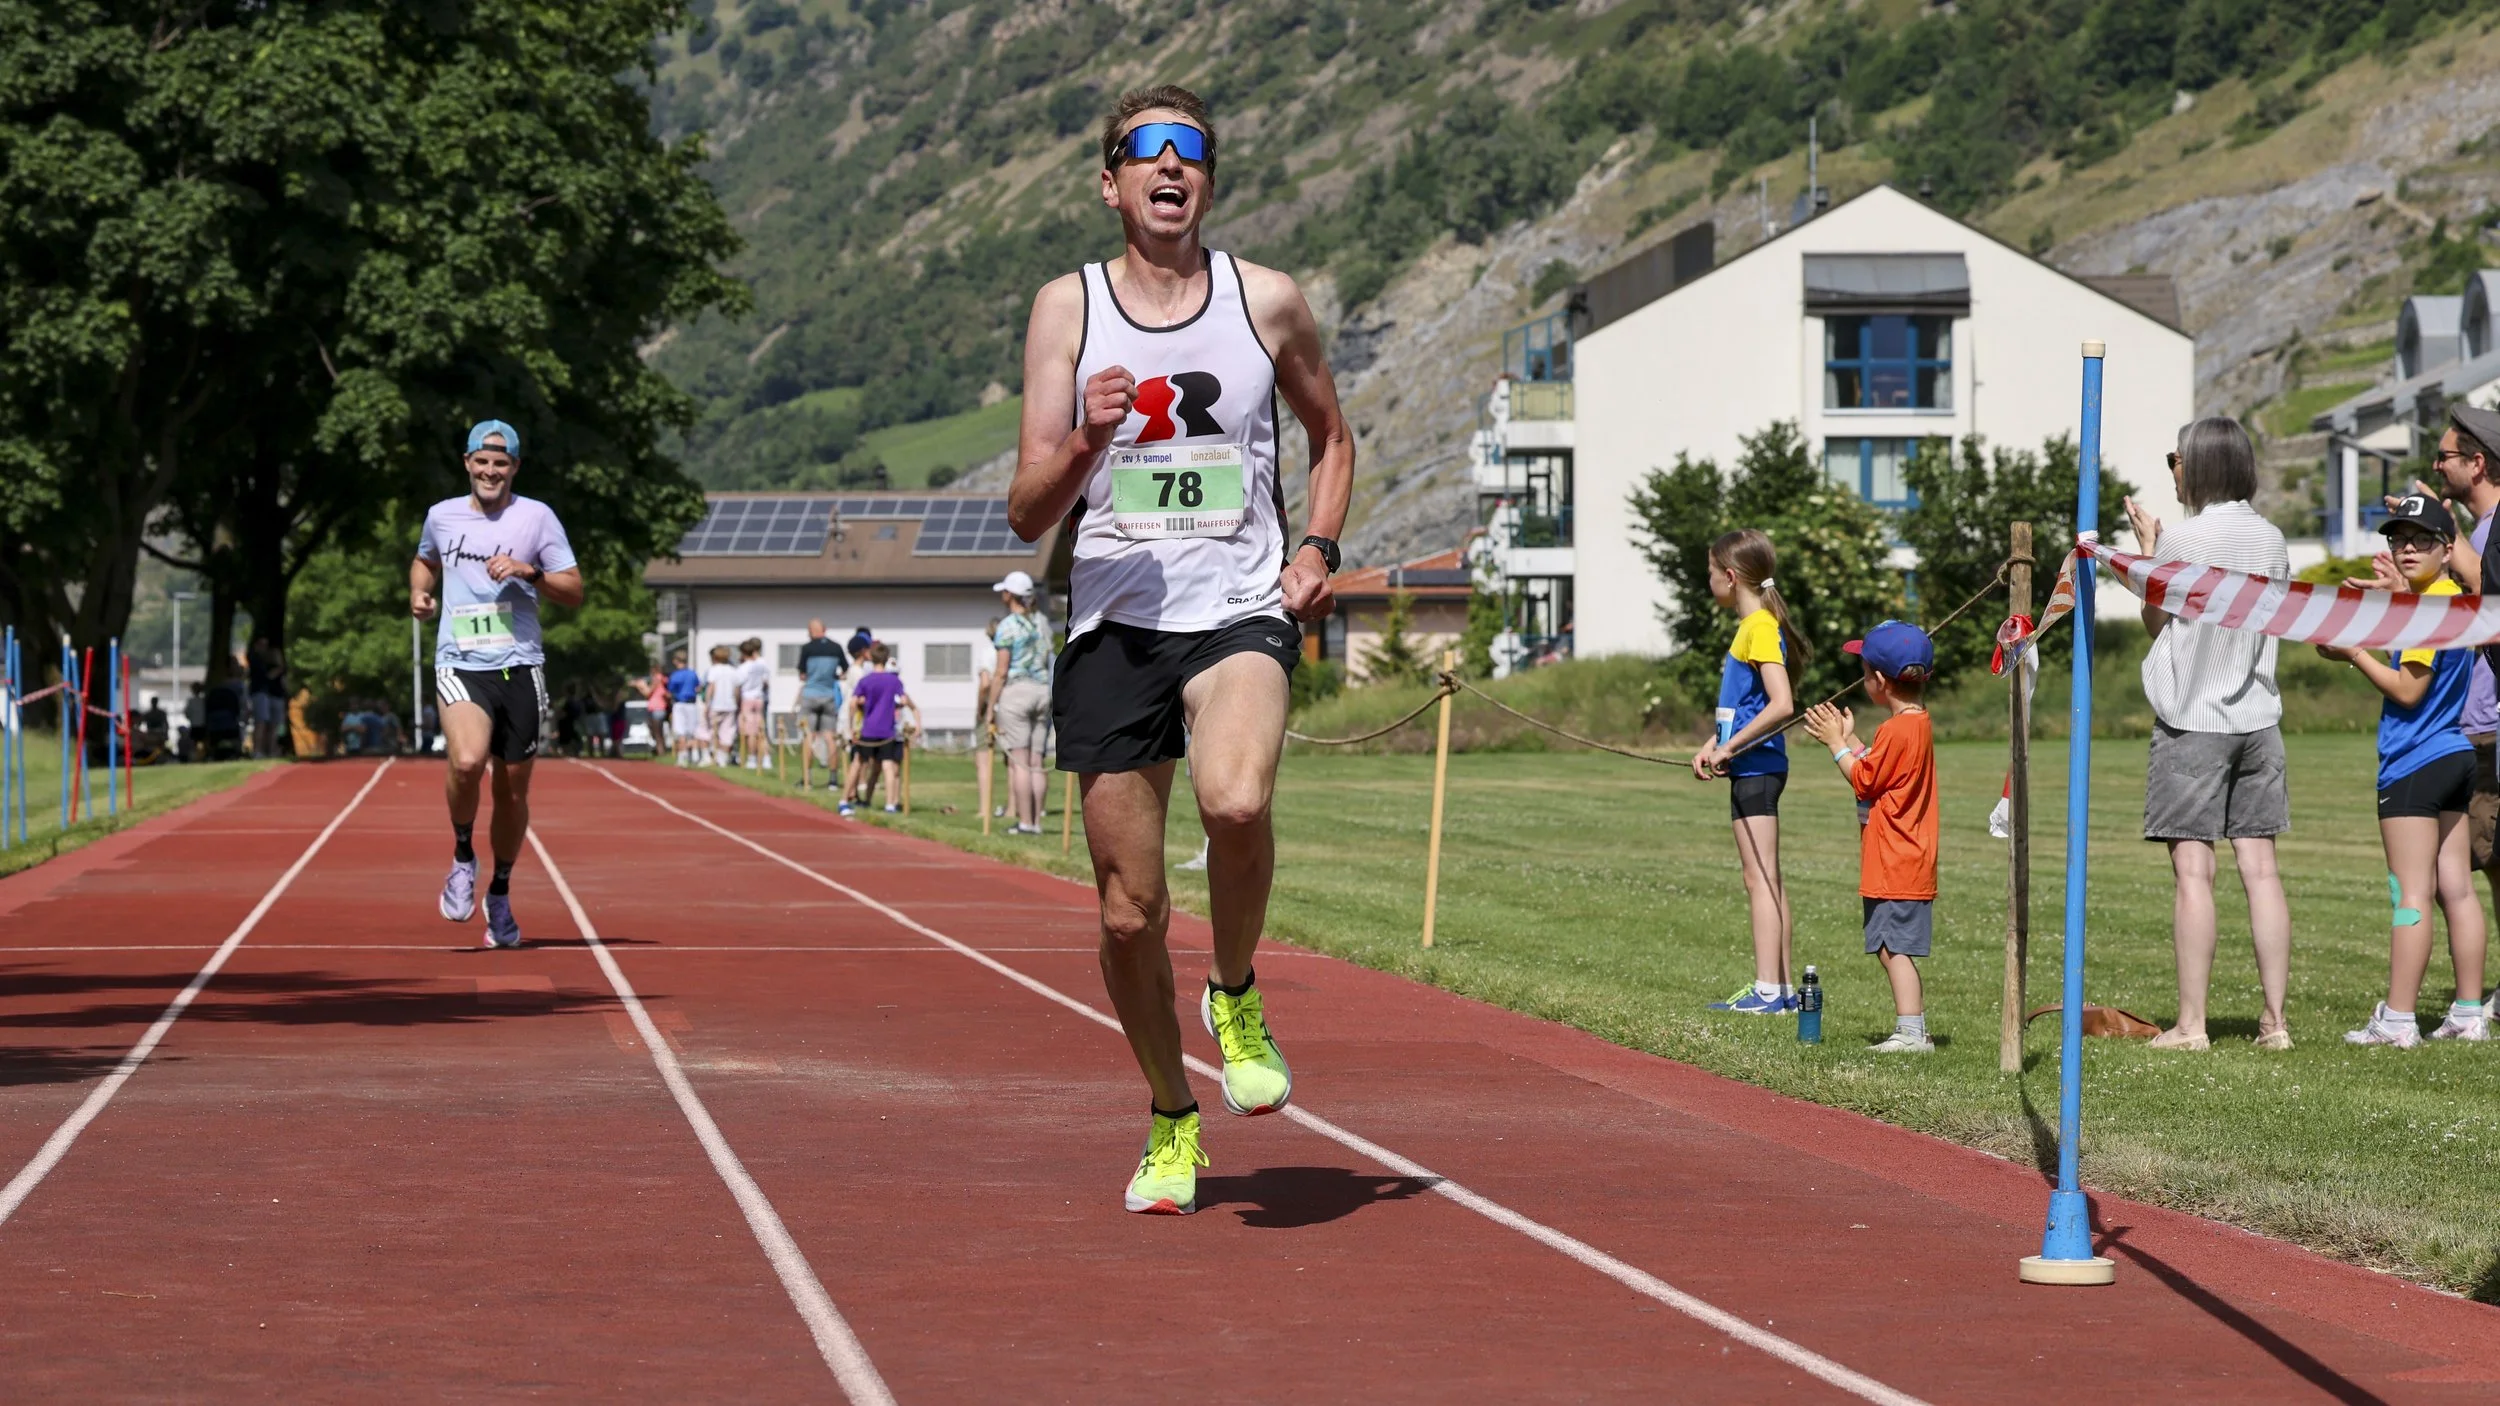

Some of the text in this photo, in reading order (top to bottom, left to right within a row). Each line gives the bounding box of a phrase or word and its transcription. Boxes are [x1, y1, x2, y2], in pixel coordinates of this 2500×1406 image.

[1121, 453, 1172, 464] stv gampel
[1190, 449, 1231, 461] lonzalauf
[1152, 471, 1203, 507] 78
[1118, 522, 1161, 530] RAIFFEISEN
[1197, 519, 1240, 528] RAIFFEISEN
[470, 616, 491, 634] 11
